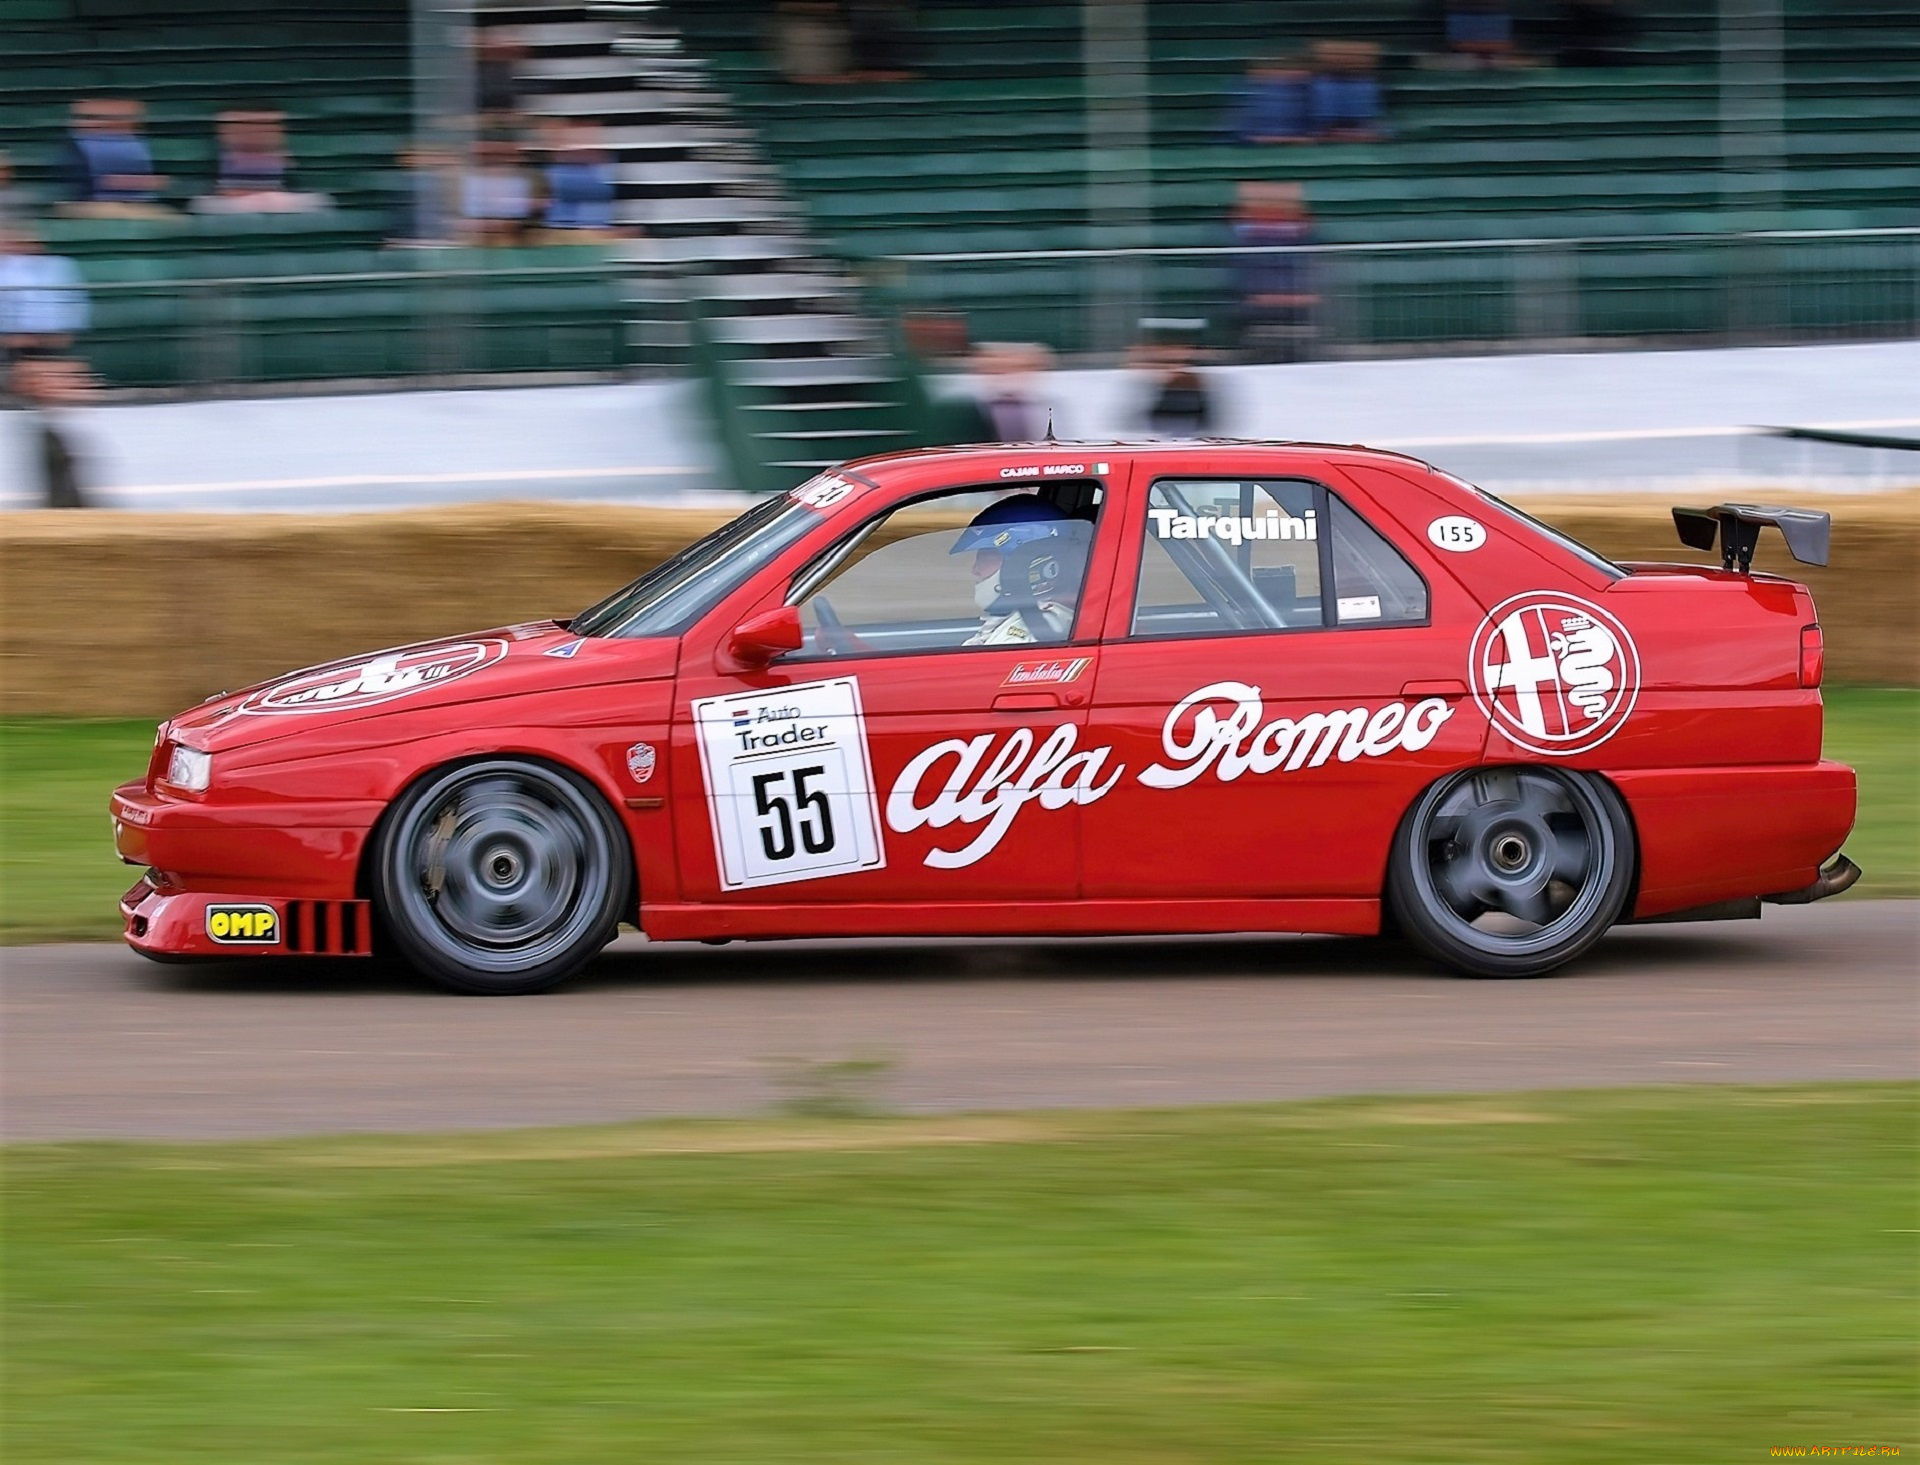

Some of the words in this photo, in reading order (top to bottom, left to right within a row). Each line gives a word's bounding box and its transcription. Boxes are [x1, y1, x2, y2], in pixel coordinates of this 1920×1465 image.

[1043, 464, 1085, 475] MARCO
[1148, 508, 1318, 546] Tarquini
[1440, 525, 1473, 542] 155
[757, 705, 801, 723] Auto
[734, 723, 828, 751] Trader
[886, 722, 1126, 869] Alfa
[1137, 680, 1455, 789] Romeo
[752, 765, 835, 861] 55
[211, 912, 275, 937] OMP
